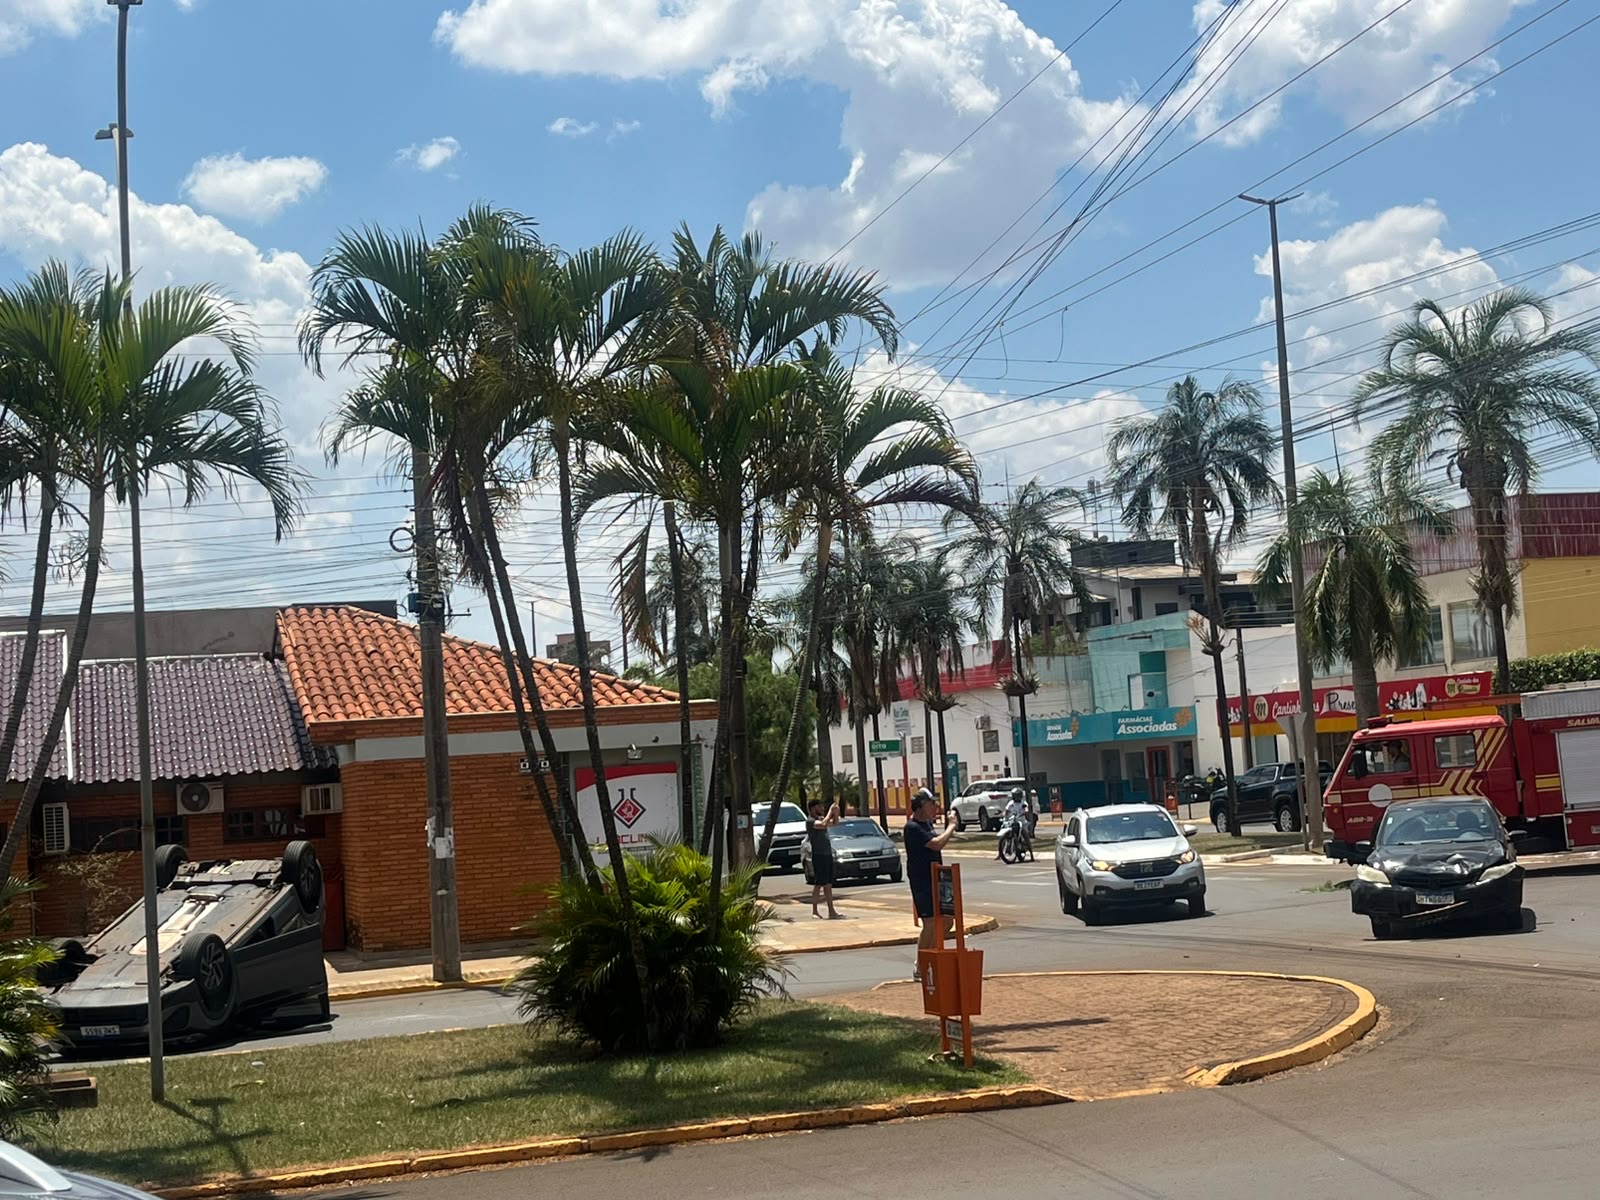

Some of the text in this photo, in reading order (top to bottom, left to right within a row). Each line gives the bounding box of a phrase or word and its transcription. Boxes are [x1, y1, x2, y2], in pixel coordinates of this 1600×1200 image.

[1272, 699, 1302, 719] Cantinh
[1117, 715, 1153, 724] FARMÁCIAS
[1116, 721, 1178, 735] Associadas
